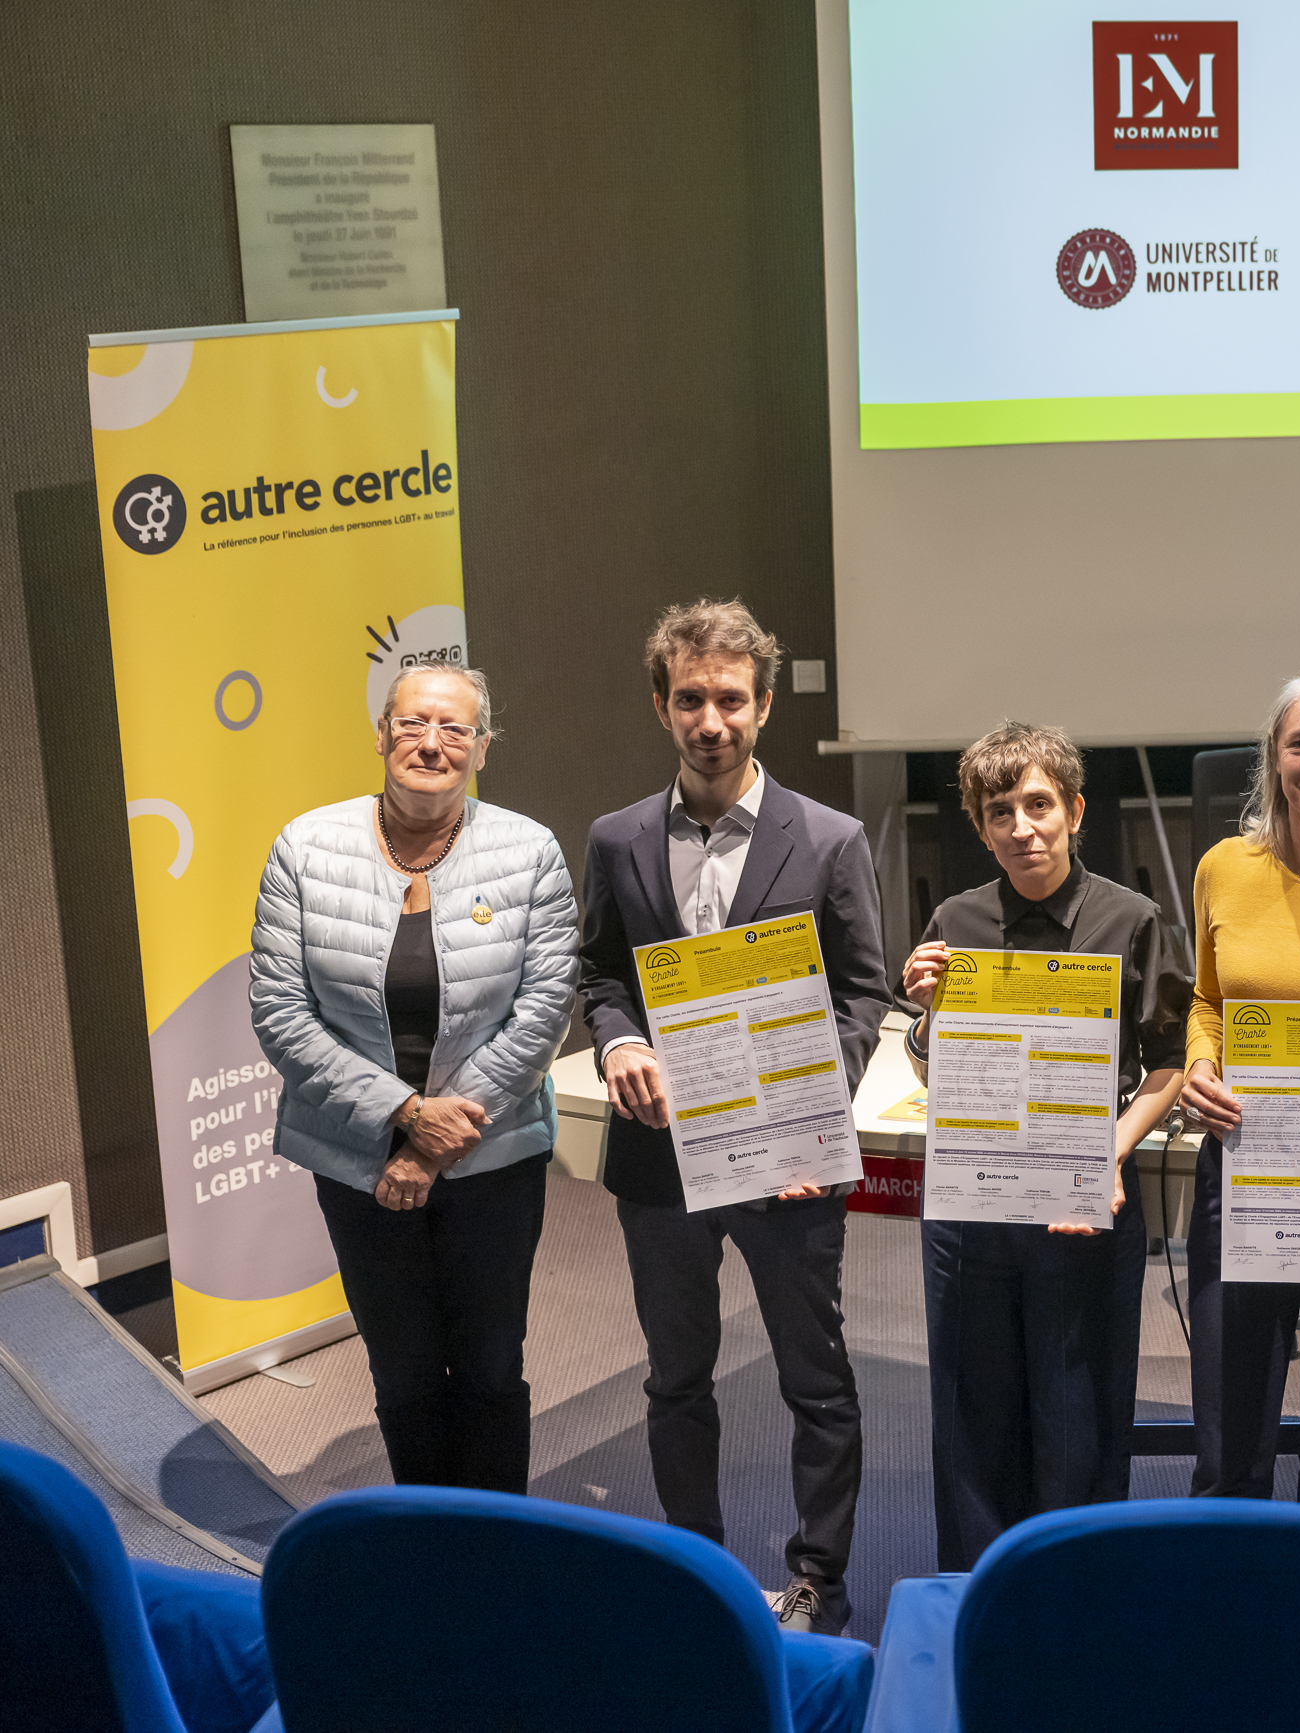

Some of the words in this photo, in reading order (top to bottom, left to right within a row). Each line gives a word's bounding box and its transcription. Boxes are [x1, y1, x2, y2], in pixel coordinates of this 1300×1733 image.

[1116, 53, 1216, 118] EM
[1114, 127, 1219, 139] NORMANDIE
[1147, 236, 1258, 264] UNIVERSITÉ
[1264, 248, 1279, 263] DE
[1147, 270, 1279, 293] MONTPELLIER
[200, 476, 322, 525] autre
[332, 449, 452, 507] cercle
[203, 541, 215, 551] La
[217, 535, 257, 550] référence
[260, 532, 280, 544] pour
[282, 525, 328, 540] l'inclusion
[330, 523, 345, 533] des
[347, 518, 393, 532] personnes
[394, 514, 421, 525] LGBT+
[424, 512, 434, 520] au
[759, 928, 781, 939] autre
[783, 922, 807, 934] cercle
[694, 946, 721, 956] Préambule
[649, 967, 680, 983] Charte
[1062, 962, 1085, 971] autre
[1087, 963, 1112, 972] cercle
[943, 975, 973, 987] Charte
[1234, 1028, 1267, 1040] Charte
[190, 1100, 247, 1141] pour
[192, 1140, 237, 1170] des
[752, 1148, 768, 1156] cercle
[195, 1160, 280, 1205] LGBT+
